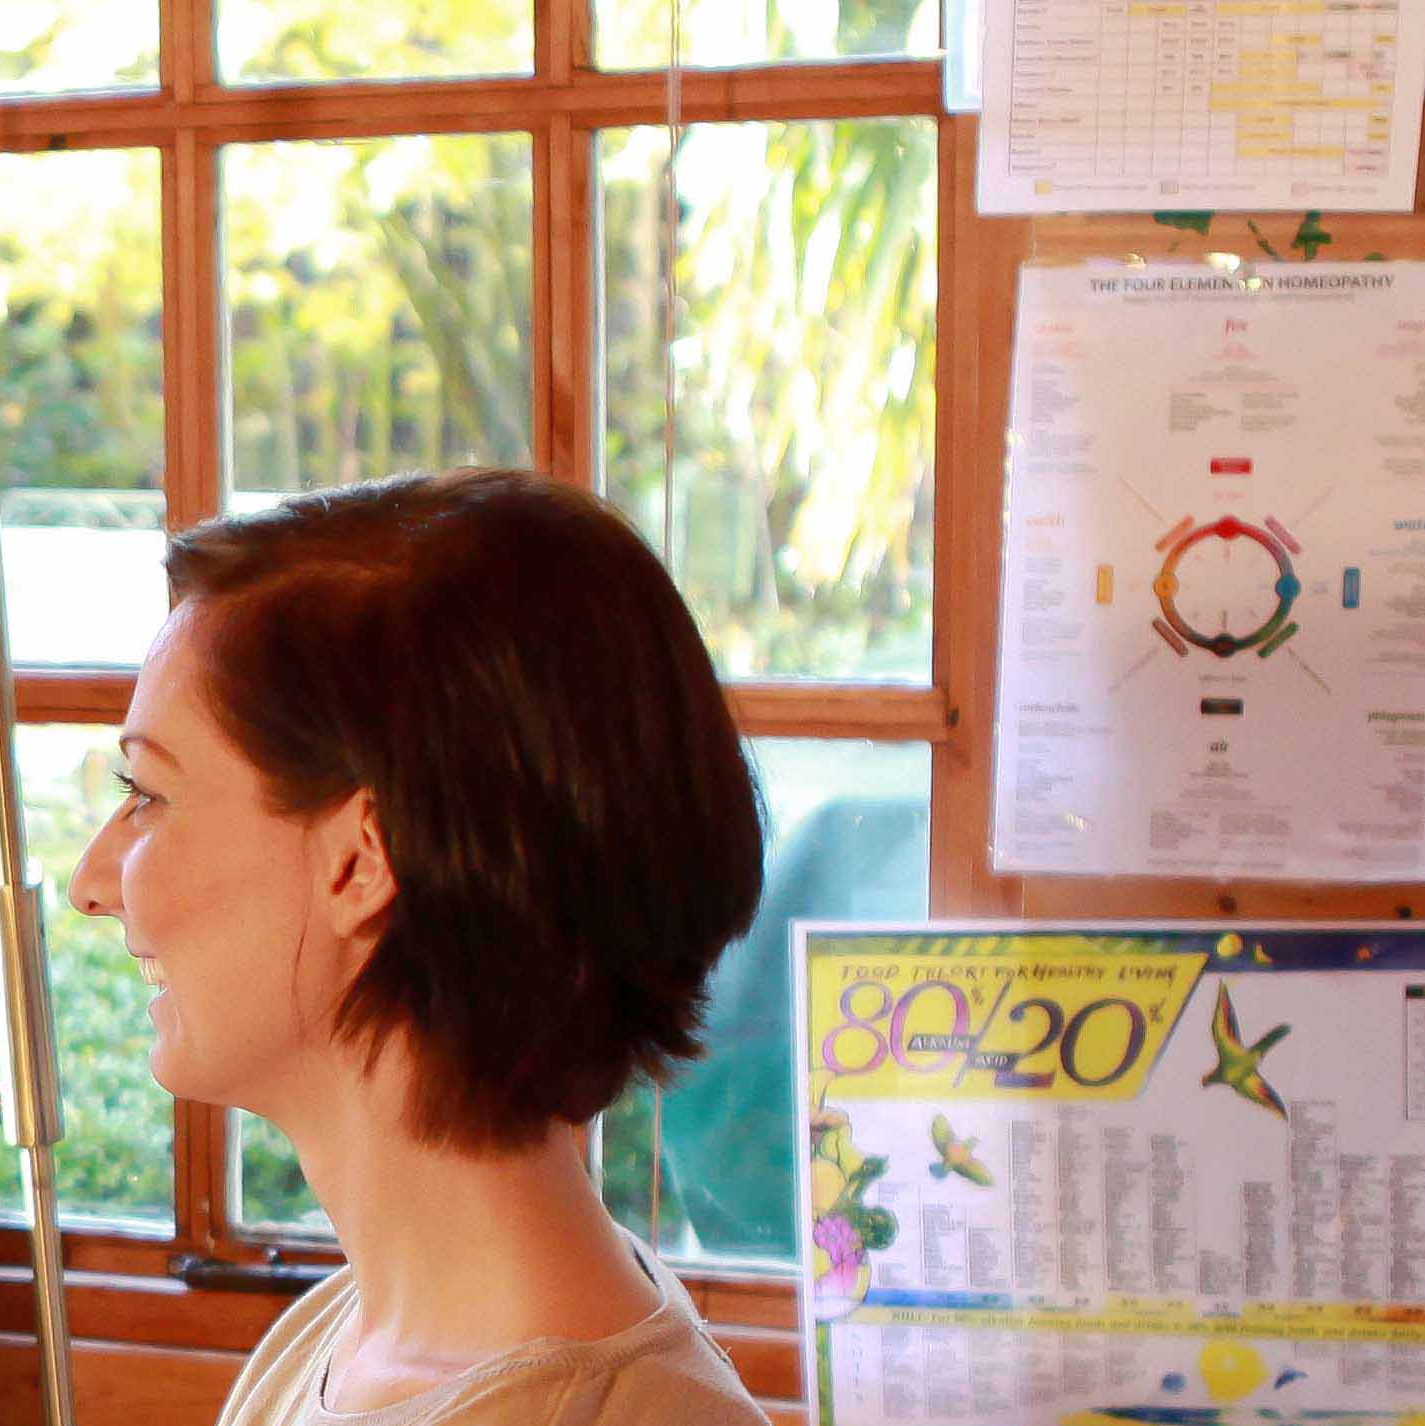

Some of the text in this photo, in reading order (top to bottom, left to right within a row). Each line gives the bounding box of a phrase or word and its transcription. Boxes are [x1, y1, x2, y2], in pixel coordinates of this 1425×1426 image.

[1089, 279, 1119, 292] THE
[1124, 278, 1165, 291] FOUR
[1278, 274, 1395, 289] HOMEOPATHY
